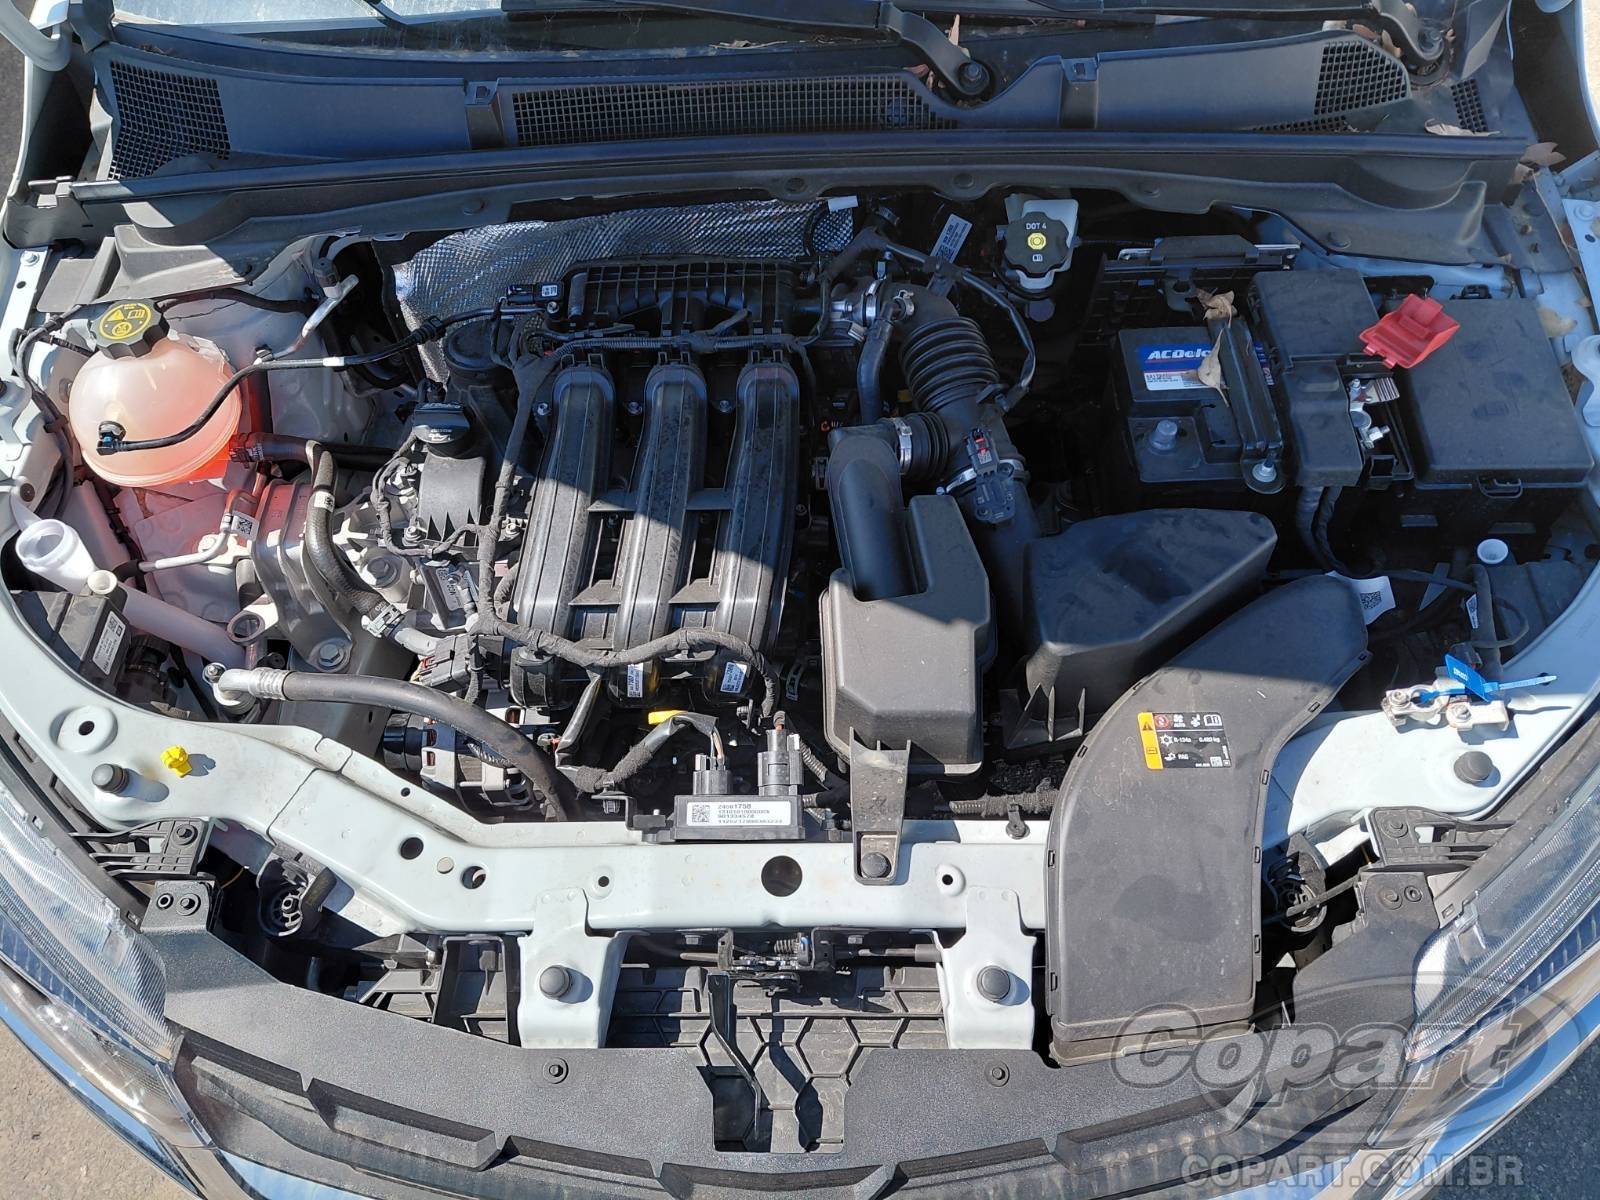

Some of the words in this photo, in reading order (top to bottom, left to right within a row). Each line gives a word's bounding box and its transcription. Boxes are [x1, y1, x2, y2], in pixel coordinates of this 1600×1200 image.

[1025, 222, 1040, 230] DOT
[1041, 222, 1047, 230] 4
[1147, 348, 1212, 360] ACDelc
